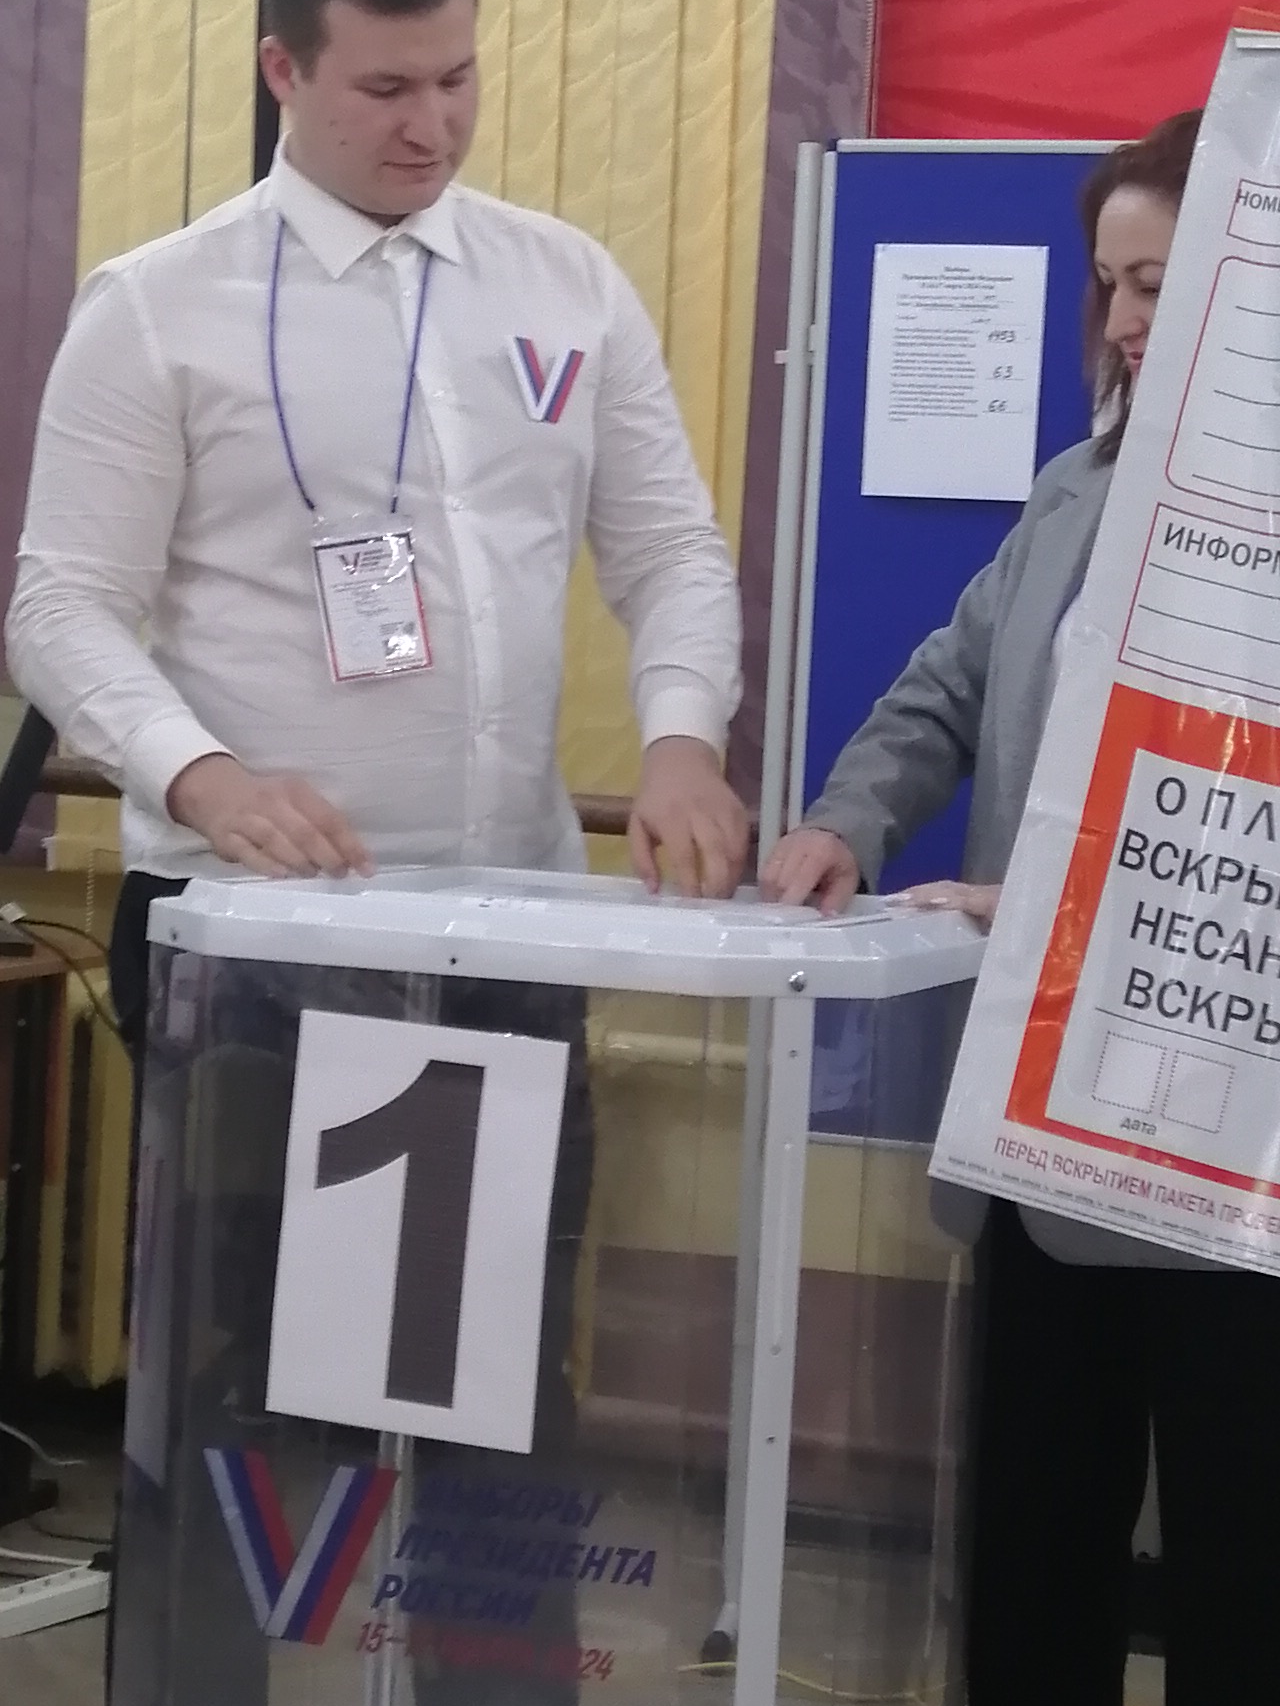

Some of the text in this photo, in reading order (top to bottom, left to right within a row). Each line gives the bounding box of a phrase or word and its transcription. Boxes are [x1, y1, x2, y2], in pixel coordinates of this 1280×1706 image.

[1121, 1117, 1157, 1137] дата
[995, 1137, 1048, 1172] ПЕРЕД
[1052, 1154, 1153, 1199] ВСКРЫТИЕМ
[1153, 1185, 1217, 1219] ПАКЕТА
[314, 1058, 485, 1409] 1
